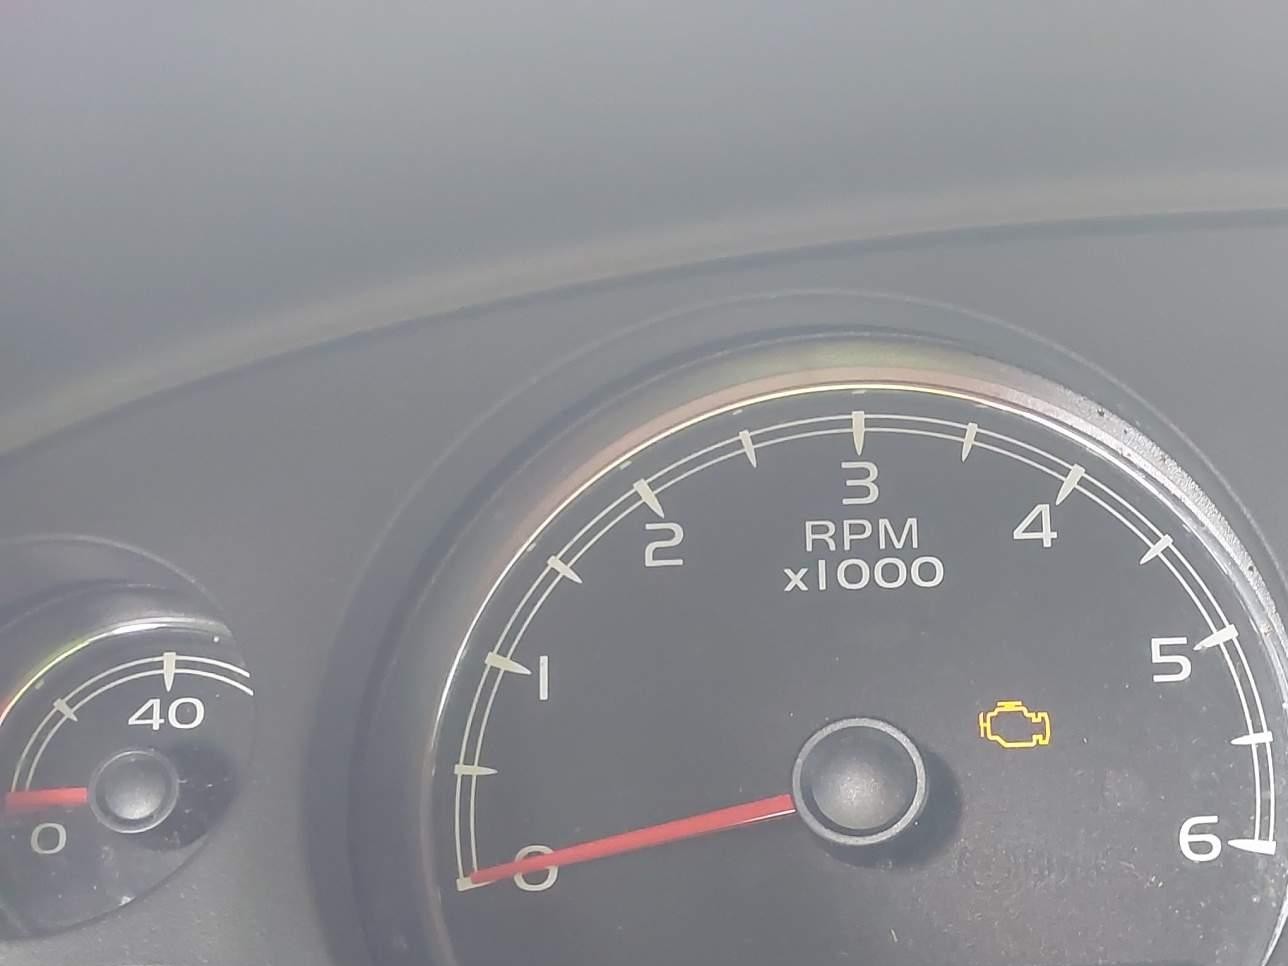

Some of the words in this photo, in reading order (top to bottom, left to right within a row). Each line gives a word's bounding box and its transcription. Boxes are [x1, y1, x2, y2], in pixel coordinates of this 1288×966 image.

[840, 461, 880, 505] 3
[643, 521, 684, 567] 2
[804, 517, 920, 552] RPM
[1012, 504, 1058, 548] 4
[783, 556, 945, 592] x1000
[538, 655, 549, 701] 1
[1150, 637, 1193, 683] 5
[127, 697, 206, 731] 40
[30, 822, 68, 856] 0
[1177, 815, 1224, 863] 6
[512, 844, 559, 893] 0
